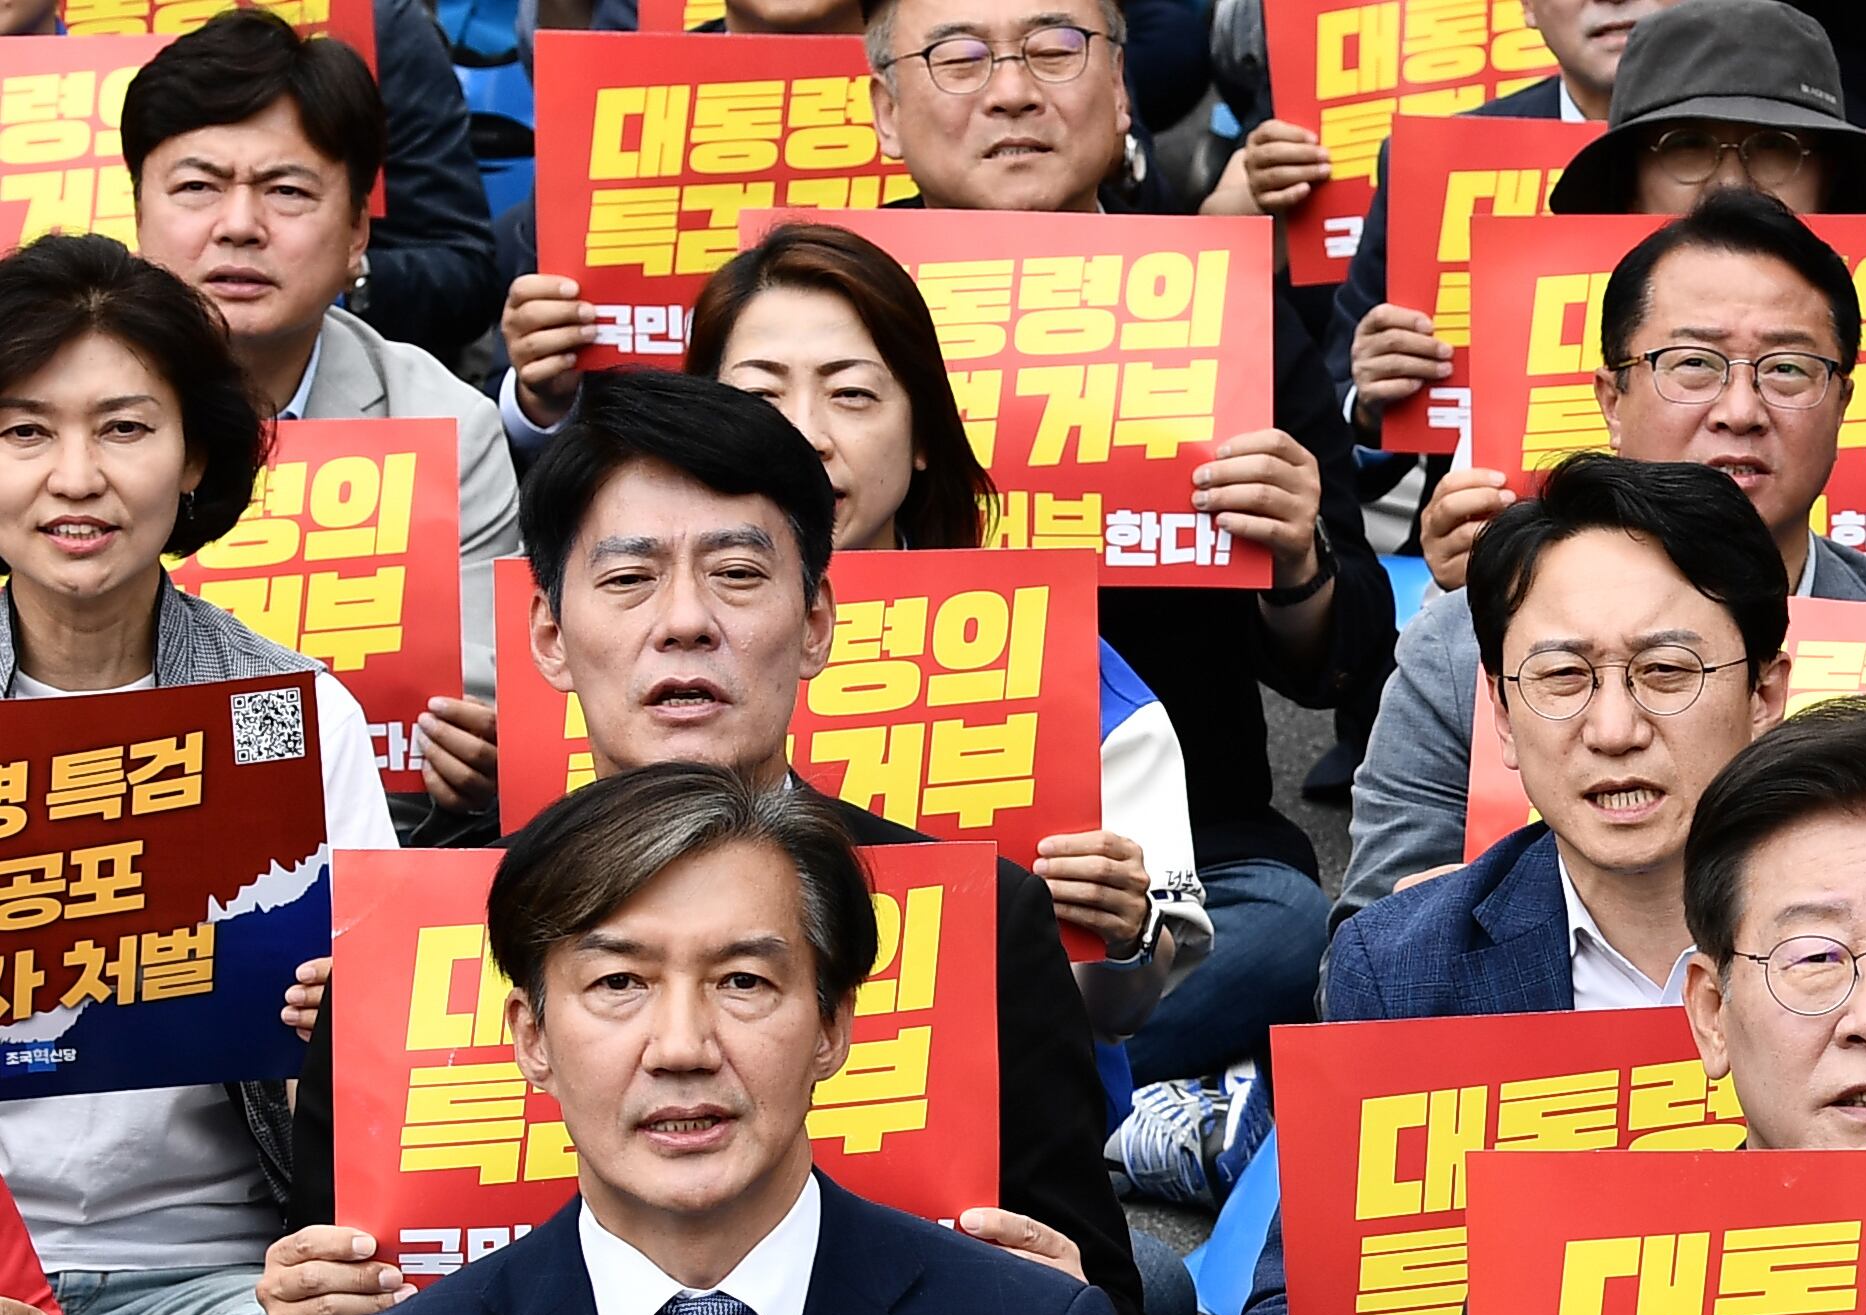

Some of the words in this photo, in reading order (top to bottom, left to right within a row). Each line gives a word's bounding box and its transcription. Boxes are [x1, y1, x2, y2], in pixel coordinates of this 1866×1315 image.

[588, 75, 905, 181] 대통령
[590, 304, 697, 355] 국민
[900, 250, 1231, 361] 통령의
[46, 731, 204, 821] 특검
[60, 922, 215, 1008] 처벌
[5, 1047, 77, 1067] 조국혁신당
